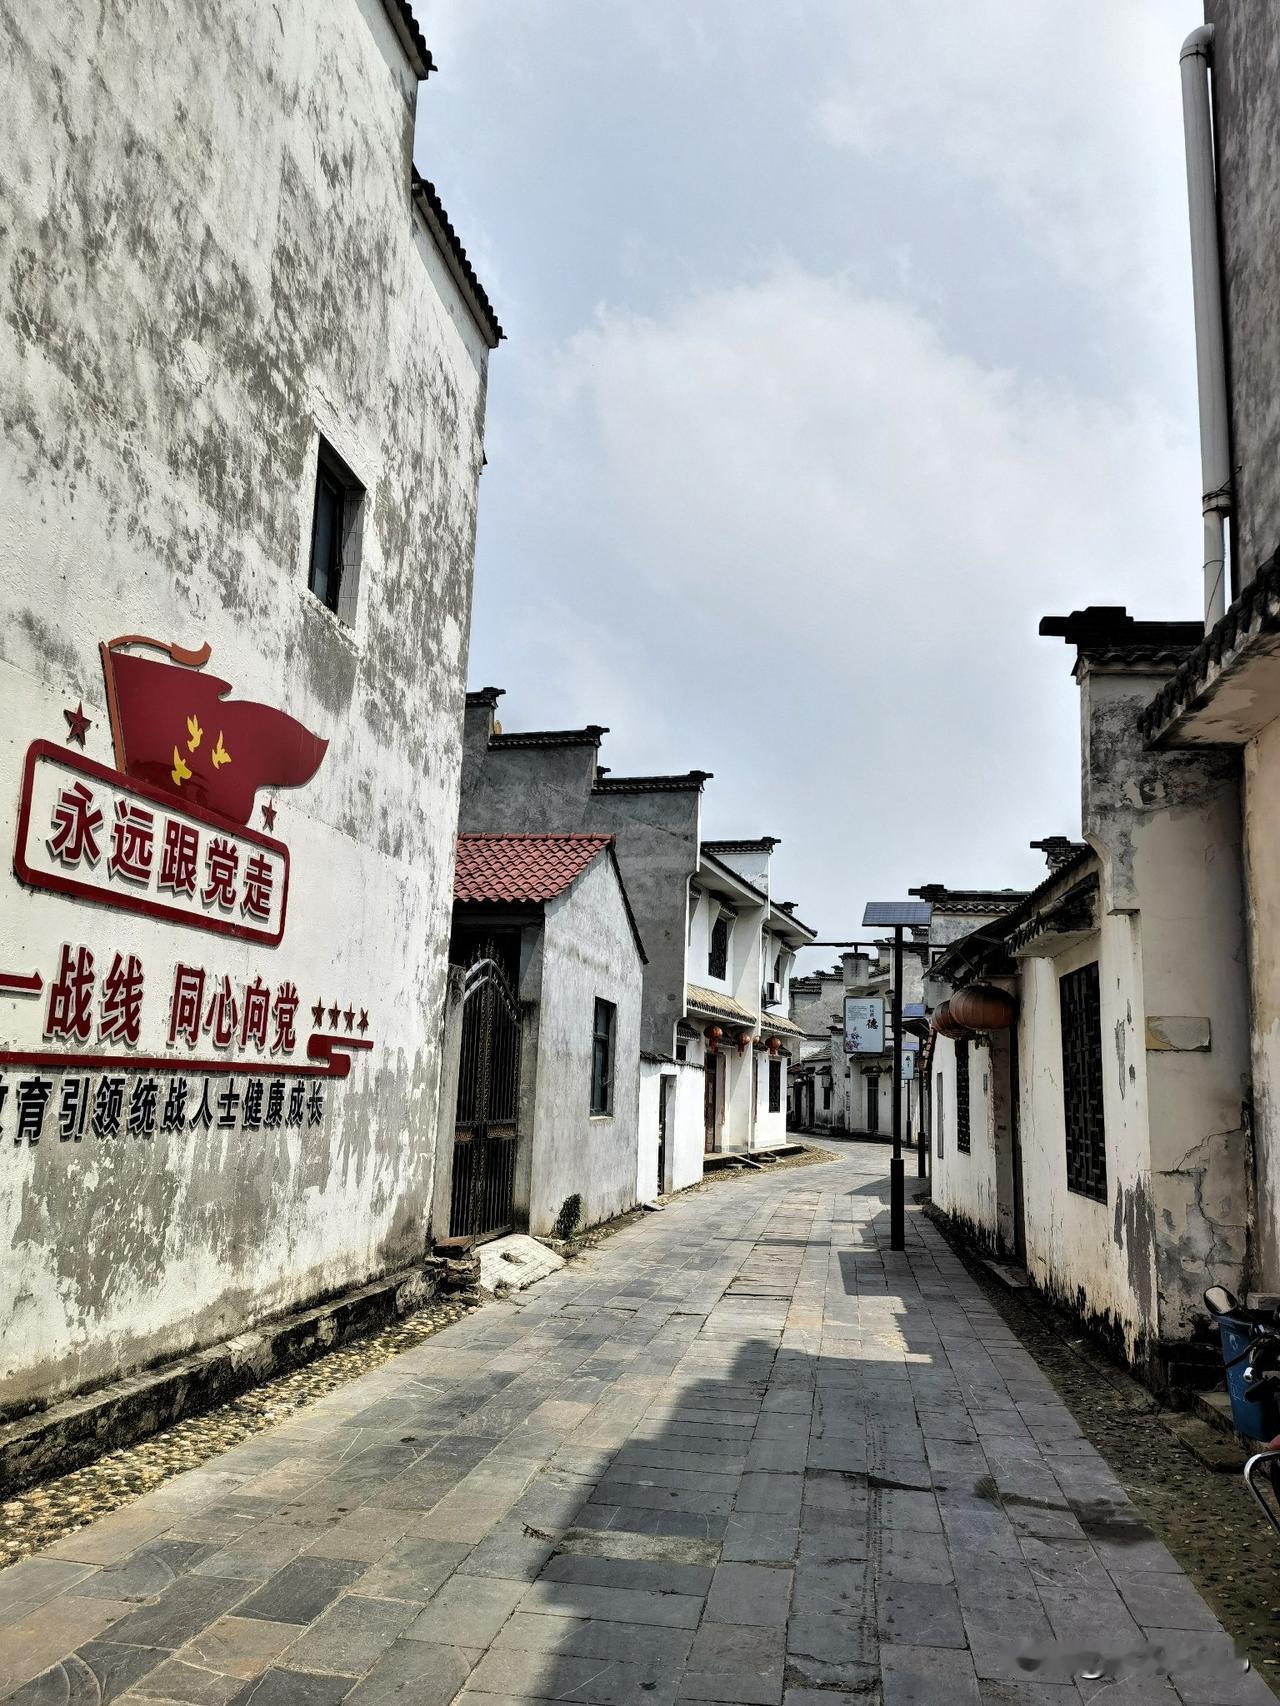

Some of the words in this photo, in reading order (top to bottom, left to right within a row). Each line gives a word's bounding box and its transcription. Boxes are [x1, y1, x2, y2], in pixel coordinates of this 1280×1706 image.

[50, 781, 274, 918] 永远跟党走
[0, 942, 144, 1044] 一战线
[167, 962, 299, 1053] 同心向党
[0, 1074, 324, 1141] 育引领统战人士健康成长
